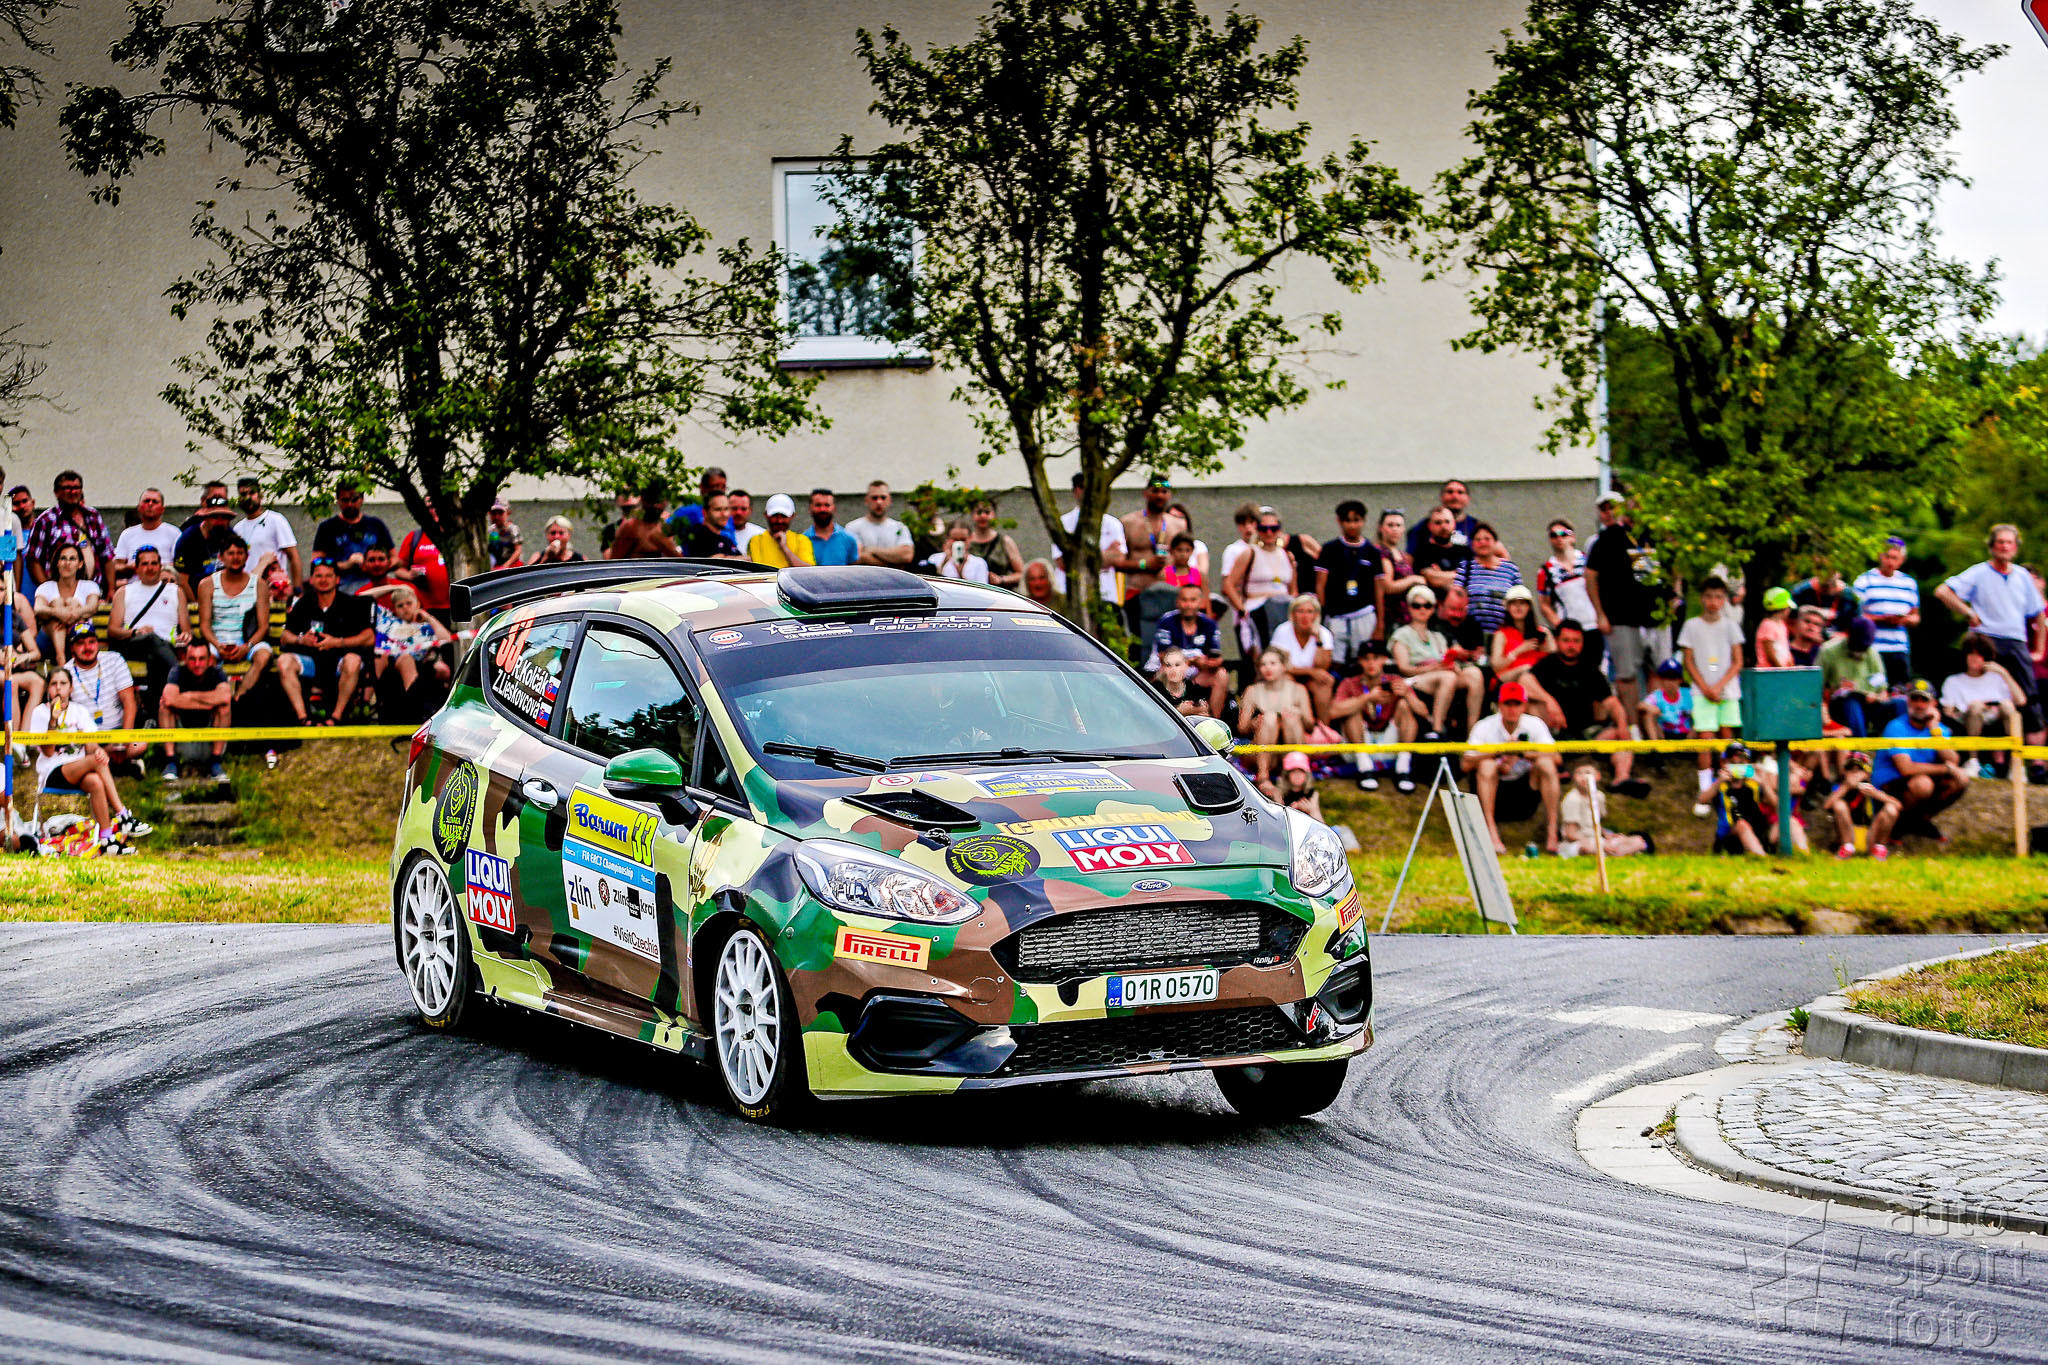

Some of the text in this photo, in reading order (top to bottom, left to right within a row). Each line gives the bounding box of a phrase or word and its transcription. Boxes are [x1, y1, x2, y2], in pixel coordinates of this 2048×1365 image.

[869, 615, 993, 625] Fiesta
[574, 803, 658, 867] Barum 33
[1059, 826, 1171, 848] LIQUI
[1073, 843, 1183, 870] MOLY
[468, 851, 510, 894] LIQUI
[468, 887, 512, 928] MOLY
[640, 898, 655, 920] kraj
[613, 923, 659, 956] #VisitCzechia
[843, 933, 921, 962] PIRELLI
[1108, 997, 1122, 1007] CZ
[1125, 974, 1214, 1002] 01R 0570
